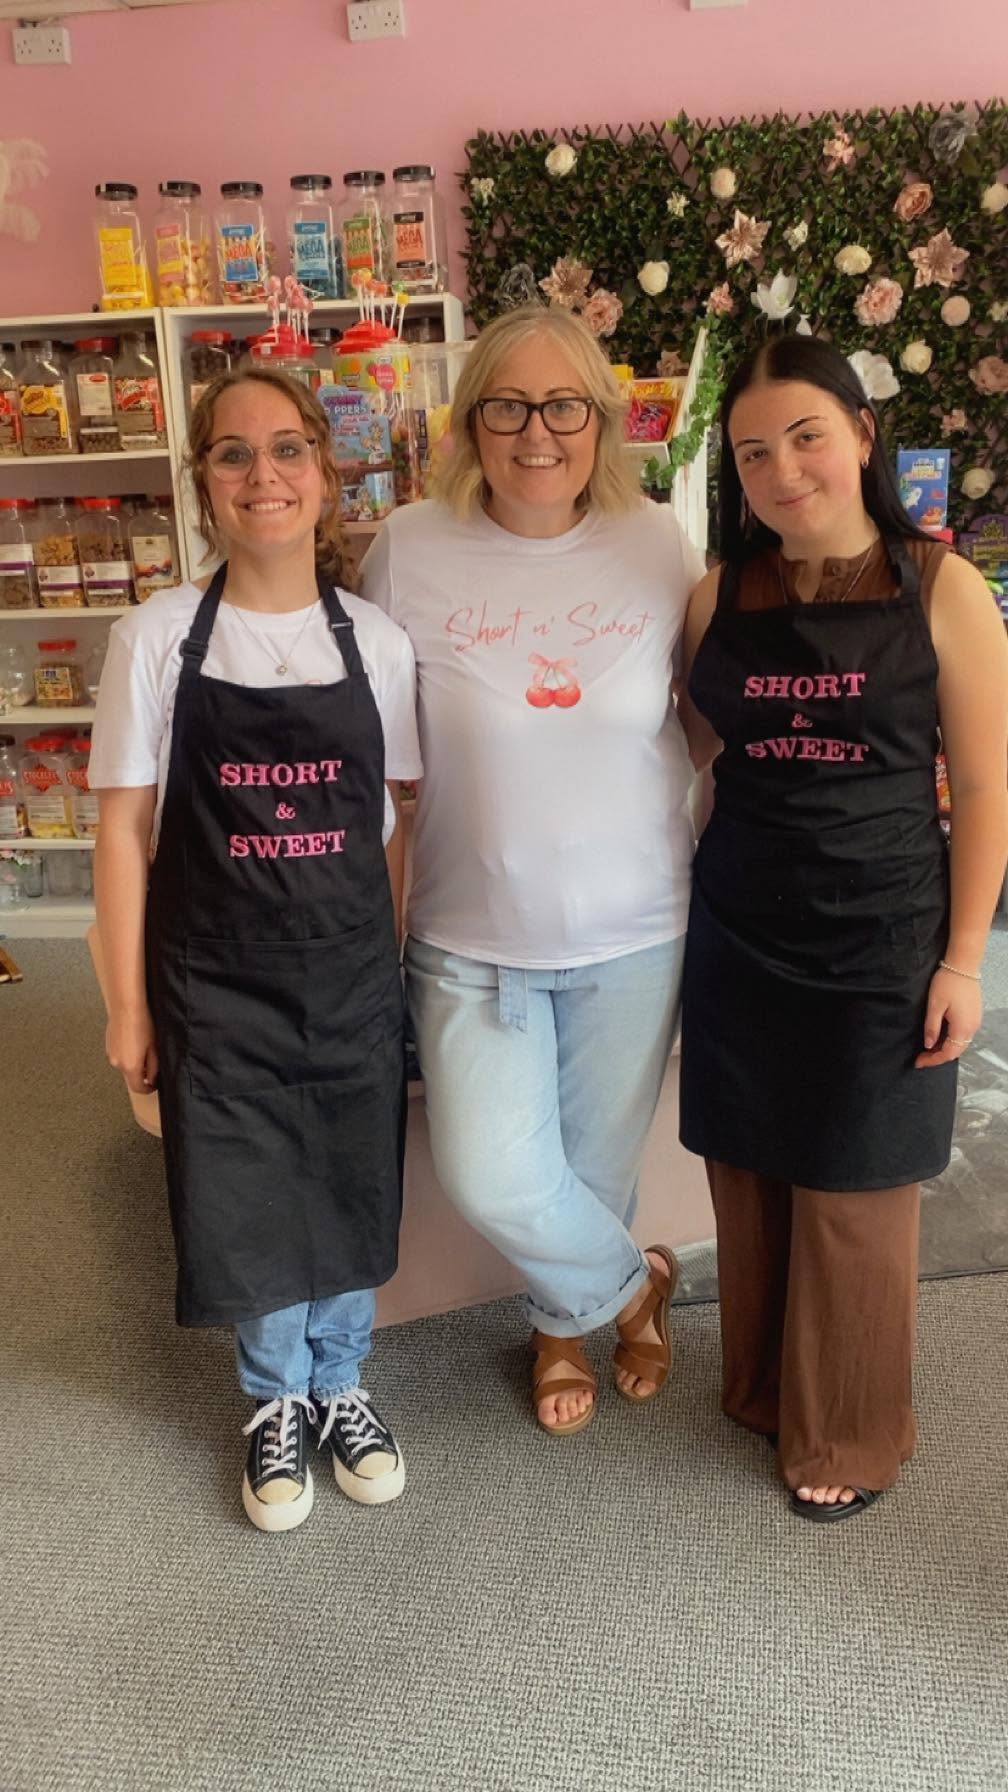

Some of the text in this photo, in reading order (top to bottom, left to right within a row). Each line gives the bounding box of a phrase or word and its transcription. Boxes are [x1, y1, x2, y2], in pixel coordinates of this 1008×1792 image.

[396, 229, 423, 246] MEGA
[445, 600, 533, 652] Short
[567, 601, 655, 646] Sweet
[744, 673, 866, 699] SHORT
[791, 713, 813, 728] &
[745, 737, 869, 761] SWEET
[220, 760, 342, 786] SHORT
[275, 802, 296, 819] &
[229, 829, 345, 858] SWEET
